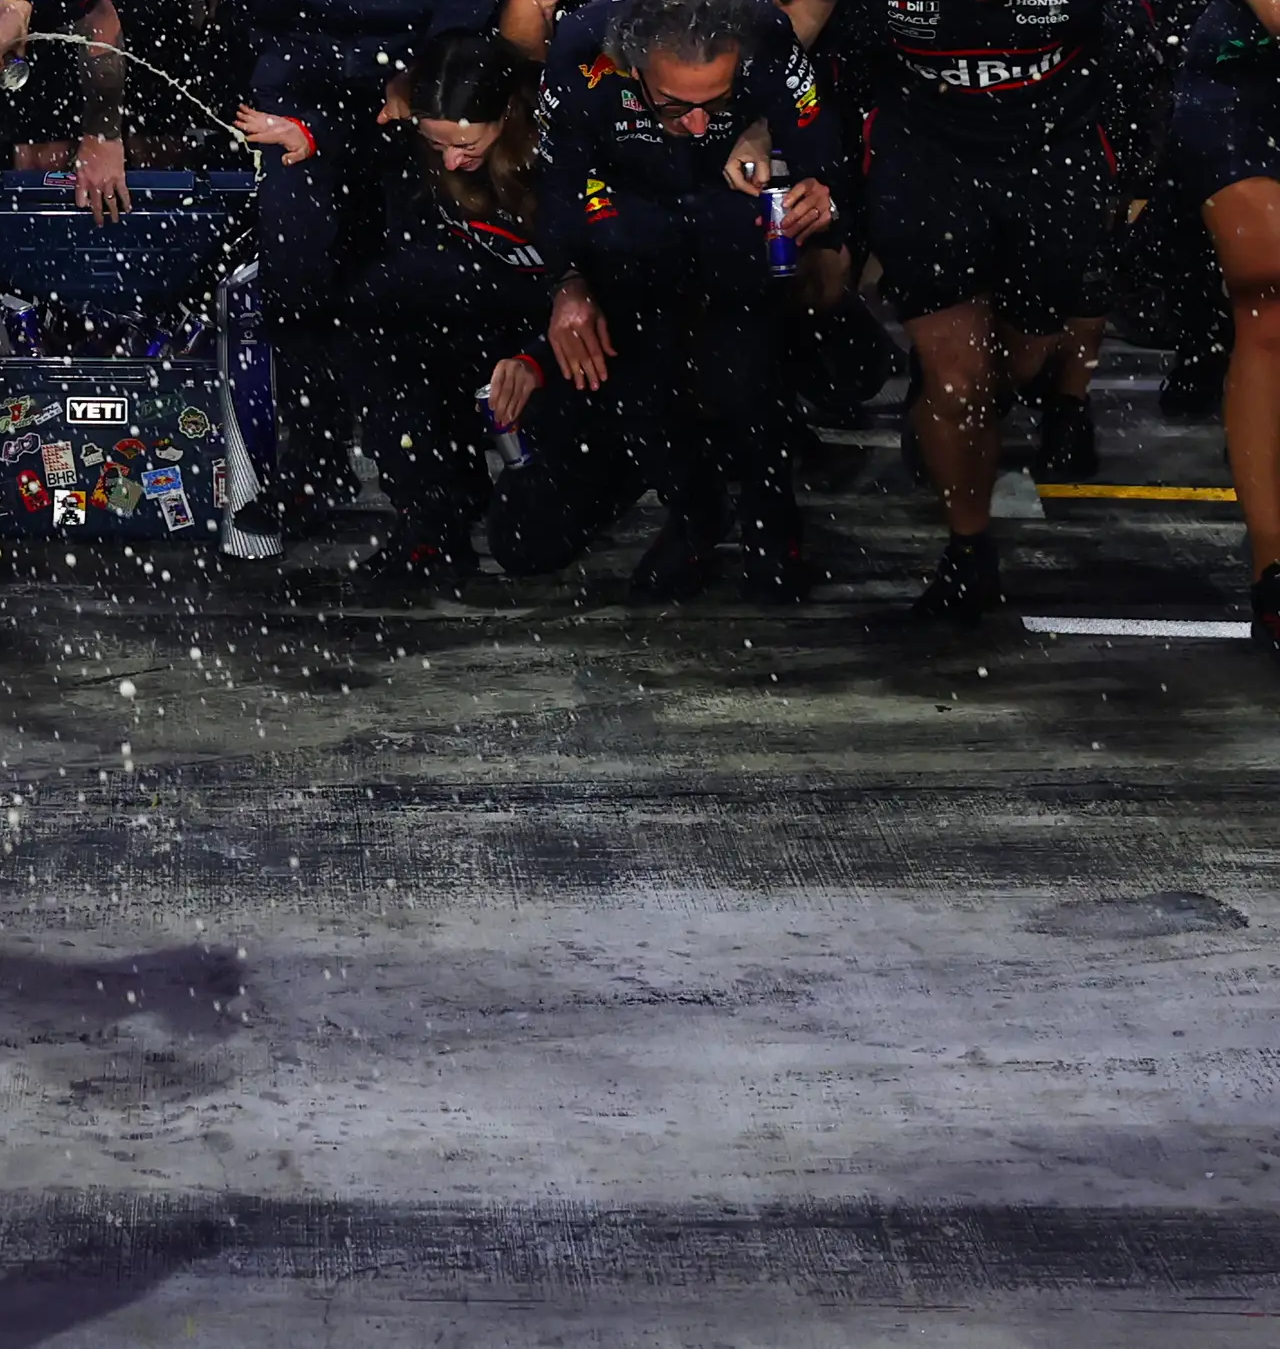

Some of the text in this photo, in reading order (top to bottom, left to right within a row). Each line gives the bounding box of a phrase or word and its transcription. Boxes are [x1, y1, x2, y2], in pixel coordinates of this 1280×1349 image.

[888, 0, 923, 12] Mobil
[888, 10, 938, 25] ORACLE
[977, 48, 1063, 88] Bull
[617, 133, 664, 144] ORACLE
[70, 402, 121, 420] YETI
[47, 470, 75, 485] BHR
